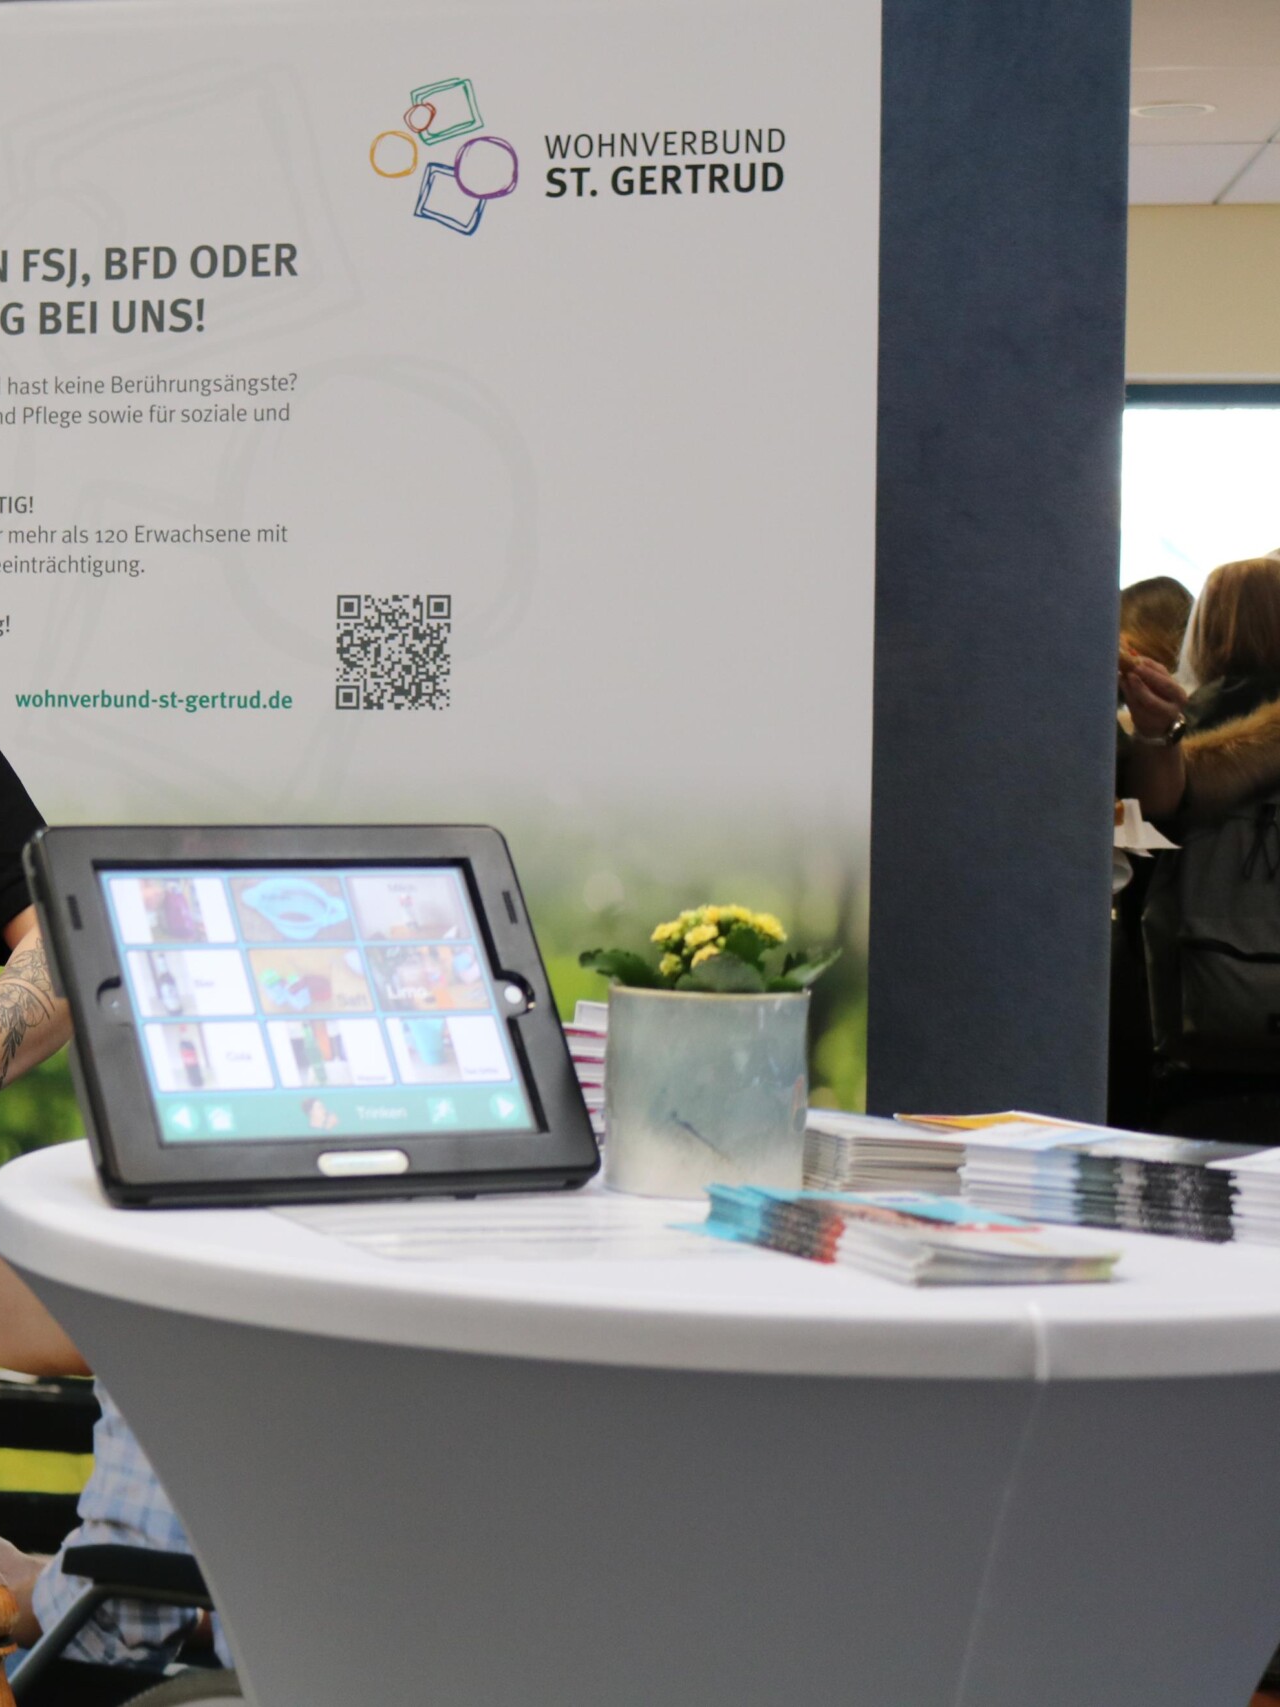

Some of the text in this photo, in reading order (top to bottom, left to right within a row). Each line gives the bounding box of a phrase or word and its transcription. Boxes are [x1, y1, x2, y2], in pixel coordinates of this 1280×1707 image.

[544, 128, 786, 160] WOHNVERBUND
[545, 161, 784, 199] ST. GERTRUD
[22, 247, 91, 289] FSJ,
[104, 246, 177, 281] BFD
[189, 242, 298, 279] ODER
[39, 300, 98, 335] BEI
[112, 298, 205, 334] UNS!
[7, 376, 49, 396] hast
[54, 375, 105, 395] keine
[111, 372, 298, 397] Berührungsängste?
[22, 405, 83, 429] Pflege
[88, 404, 144, 425] sowie
[149, 404, 176, 424] für
[180, 403, 248, 424] soziale
[253, 402, 290, 423] und
[8, 524, 57, 544] mehr
[61, 524, 89, 544] als
[95, 529, 129, 544] 120
[134, 523, 251, 544] Erwachsene
[257, 523, 288, 543] mit
[15, 689, 293, 714] wohnverbund-st-gertrud.de
